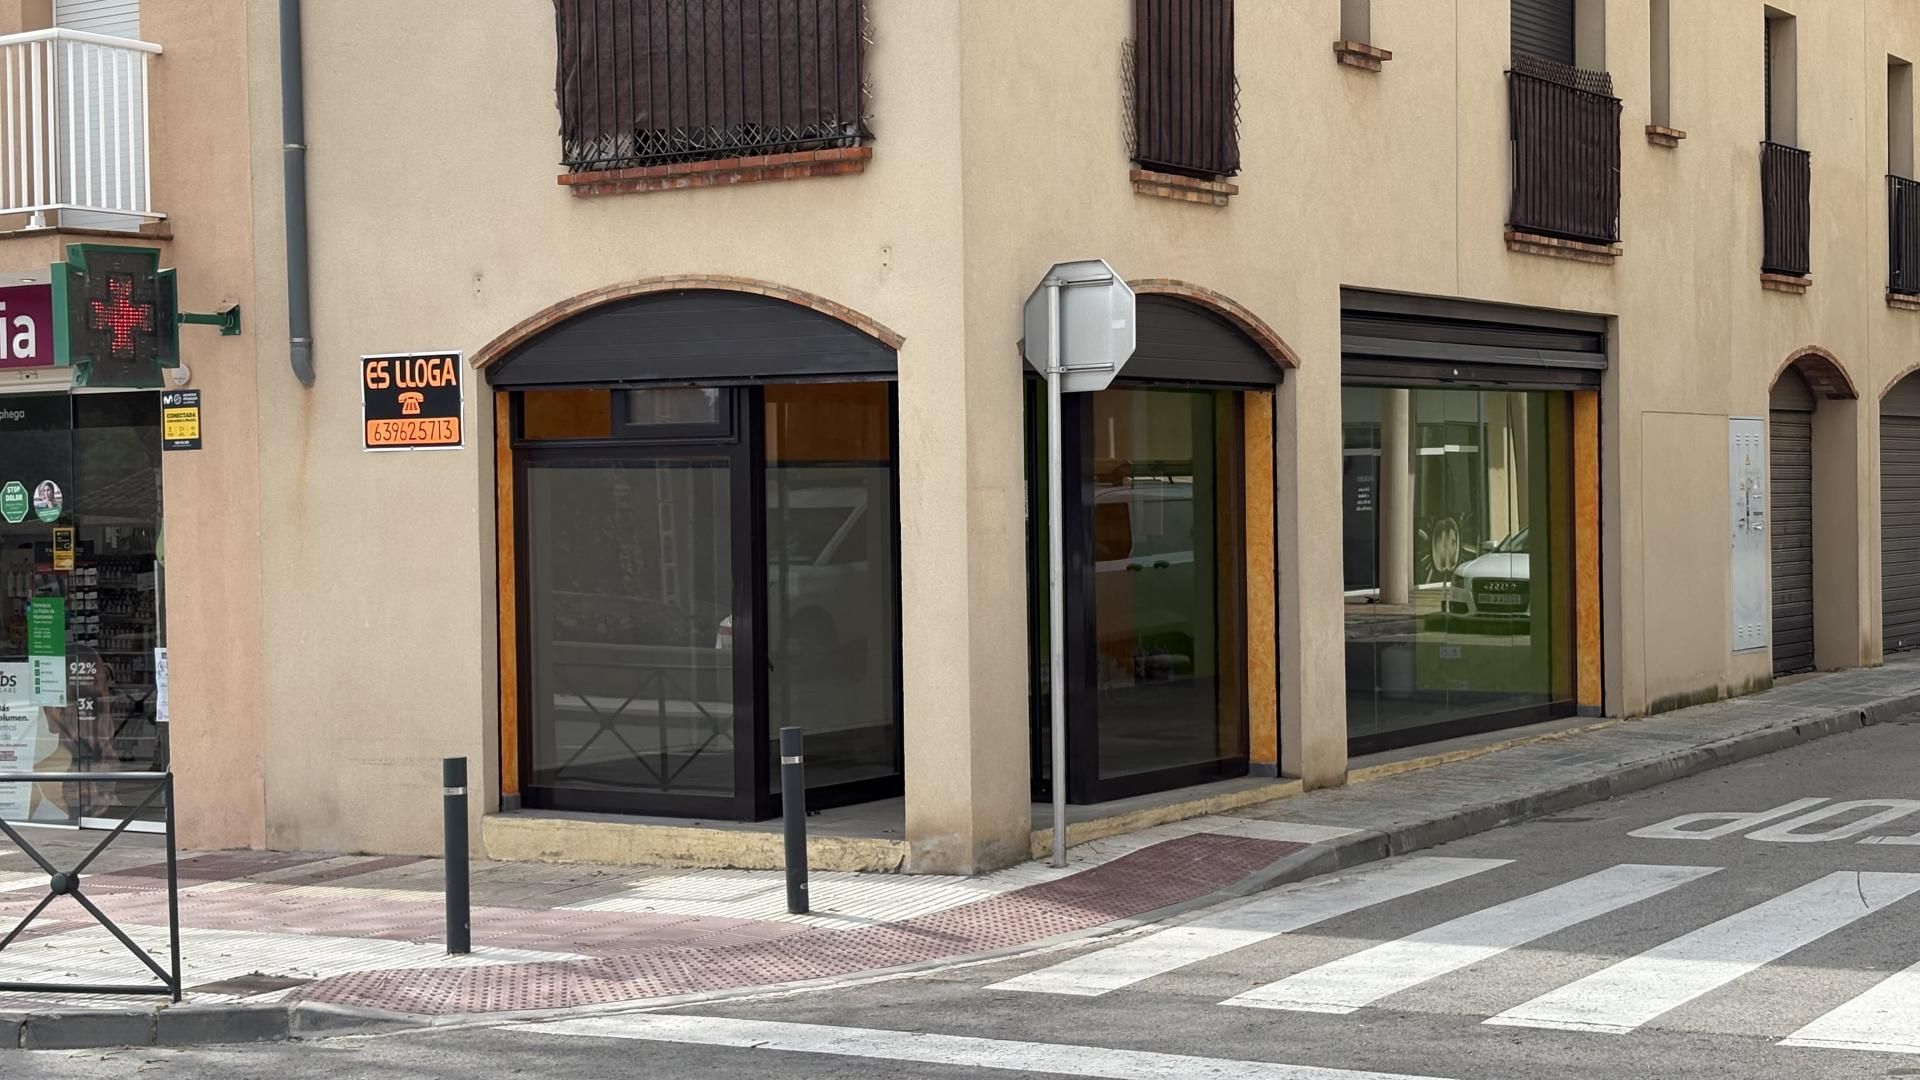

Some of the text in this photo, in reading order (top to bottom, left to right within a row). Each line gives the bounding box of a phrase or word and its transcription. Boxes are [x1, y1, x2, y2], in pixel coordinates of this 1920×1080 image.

[366, 357, 457, 390] ES LLOGA
[374, 420, 453, 442] 639625713
[7, 486, 21, 494] STOP
[70, 662, 97, 675] 92%
[78, 698, 94, 710] 3x
